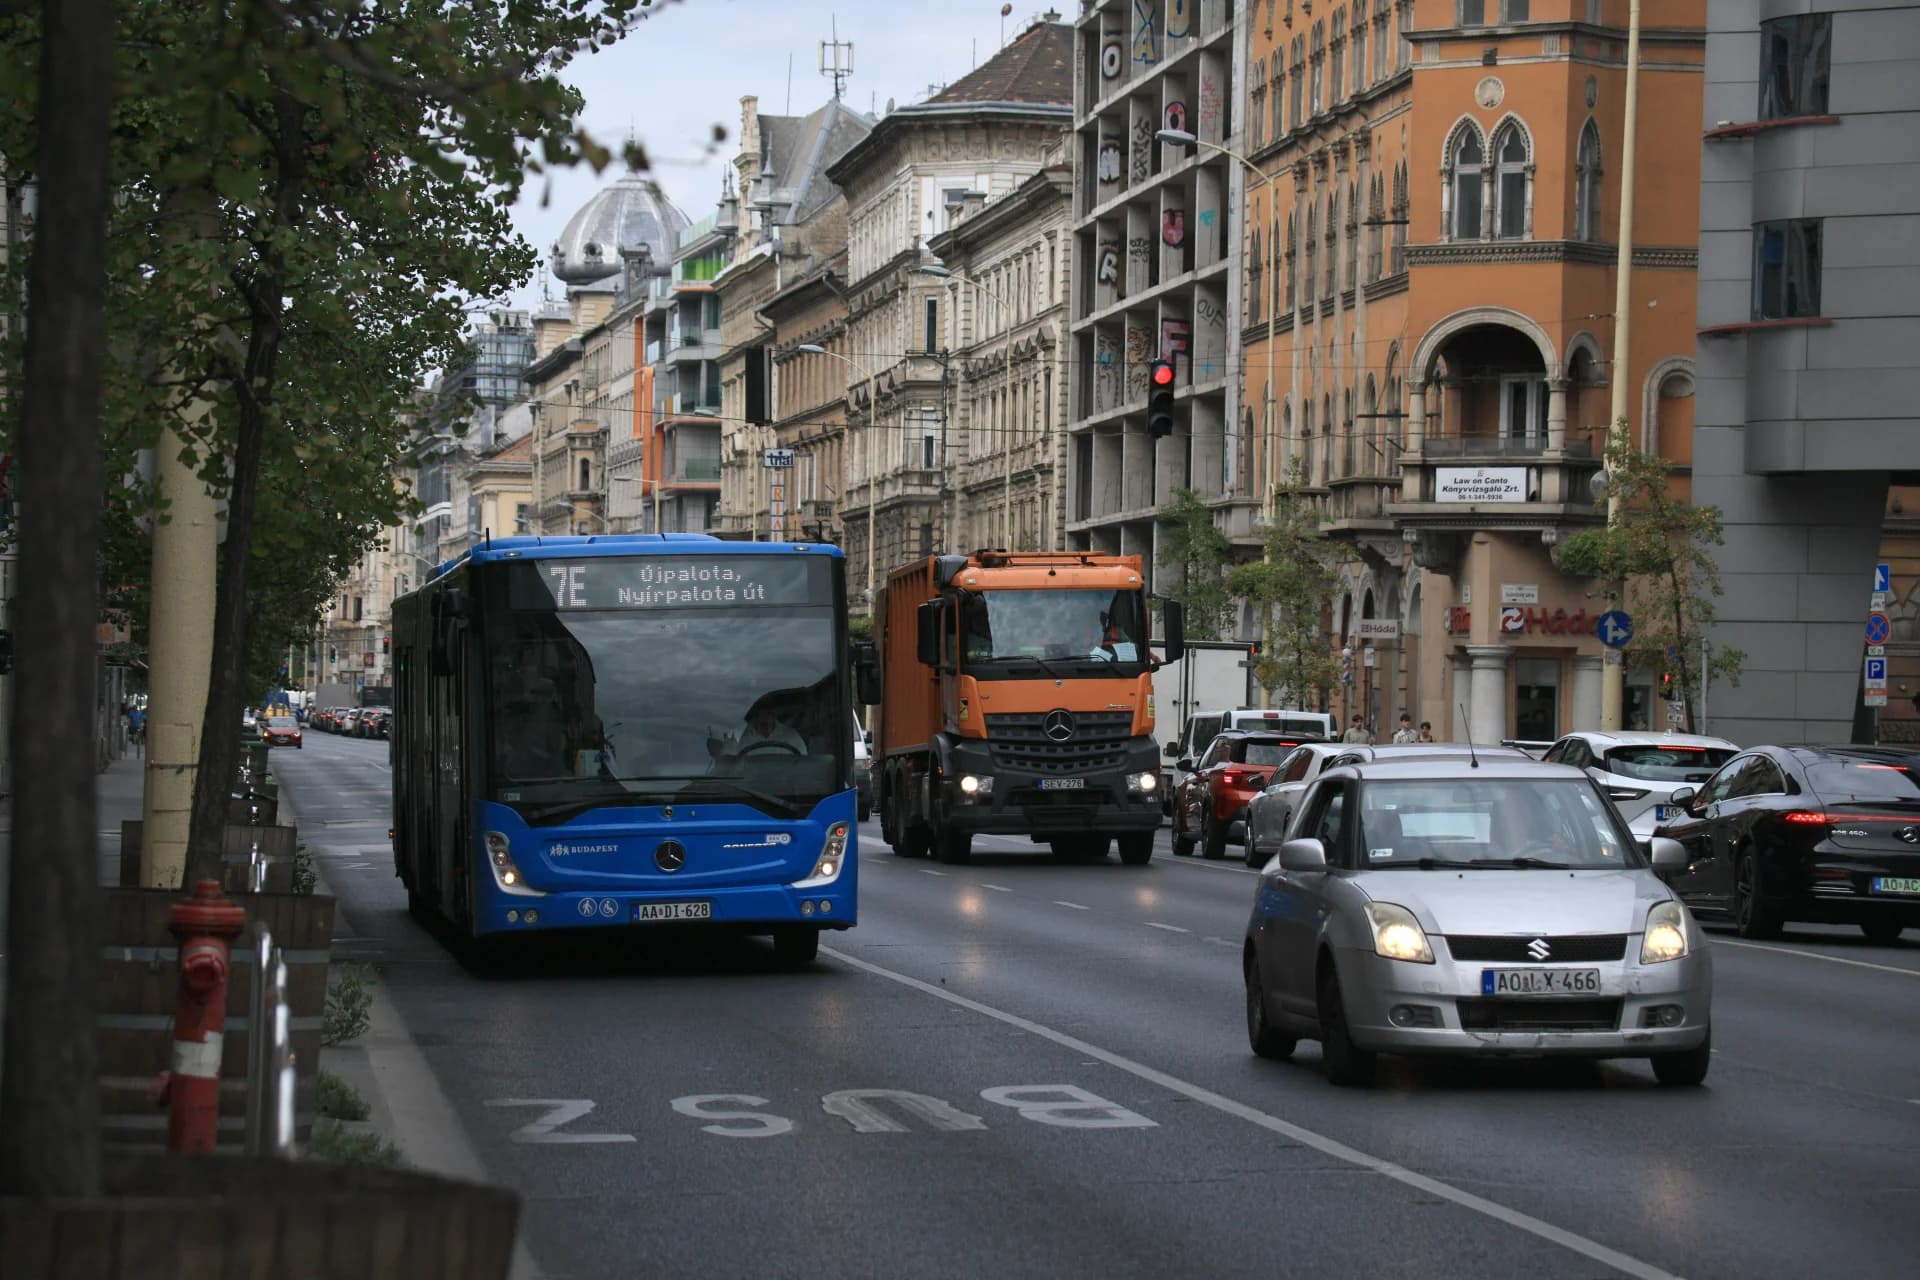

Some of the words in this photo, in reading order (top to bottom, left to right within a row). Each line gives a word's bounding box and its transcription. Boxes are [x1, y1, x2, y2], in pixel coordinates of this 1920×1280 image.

[767, 451, 794, 466] trial
[1453, 477, 1471, 485] Law
[1484, 477, 1508, 485] Conto
[1504, 485, 1520, 493] Zrt.
[550, 566, 587, 607] 7E
[640, 564, 742, 583] Újpalota,
[618, 585, 736, 606] Nyírpalota
[743, 582, 765, 600] út
[1871, 662, 1881, 677] P
[571, 844, 619, 854] BUDAPEST
